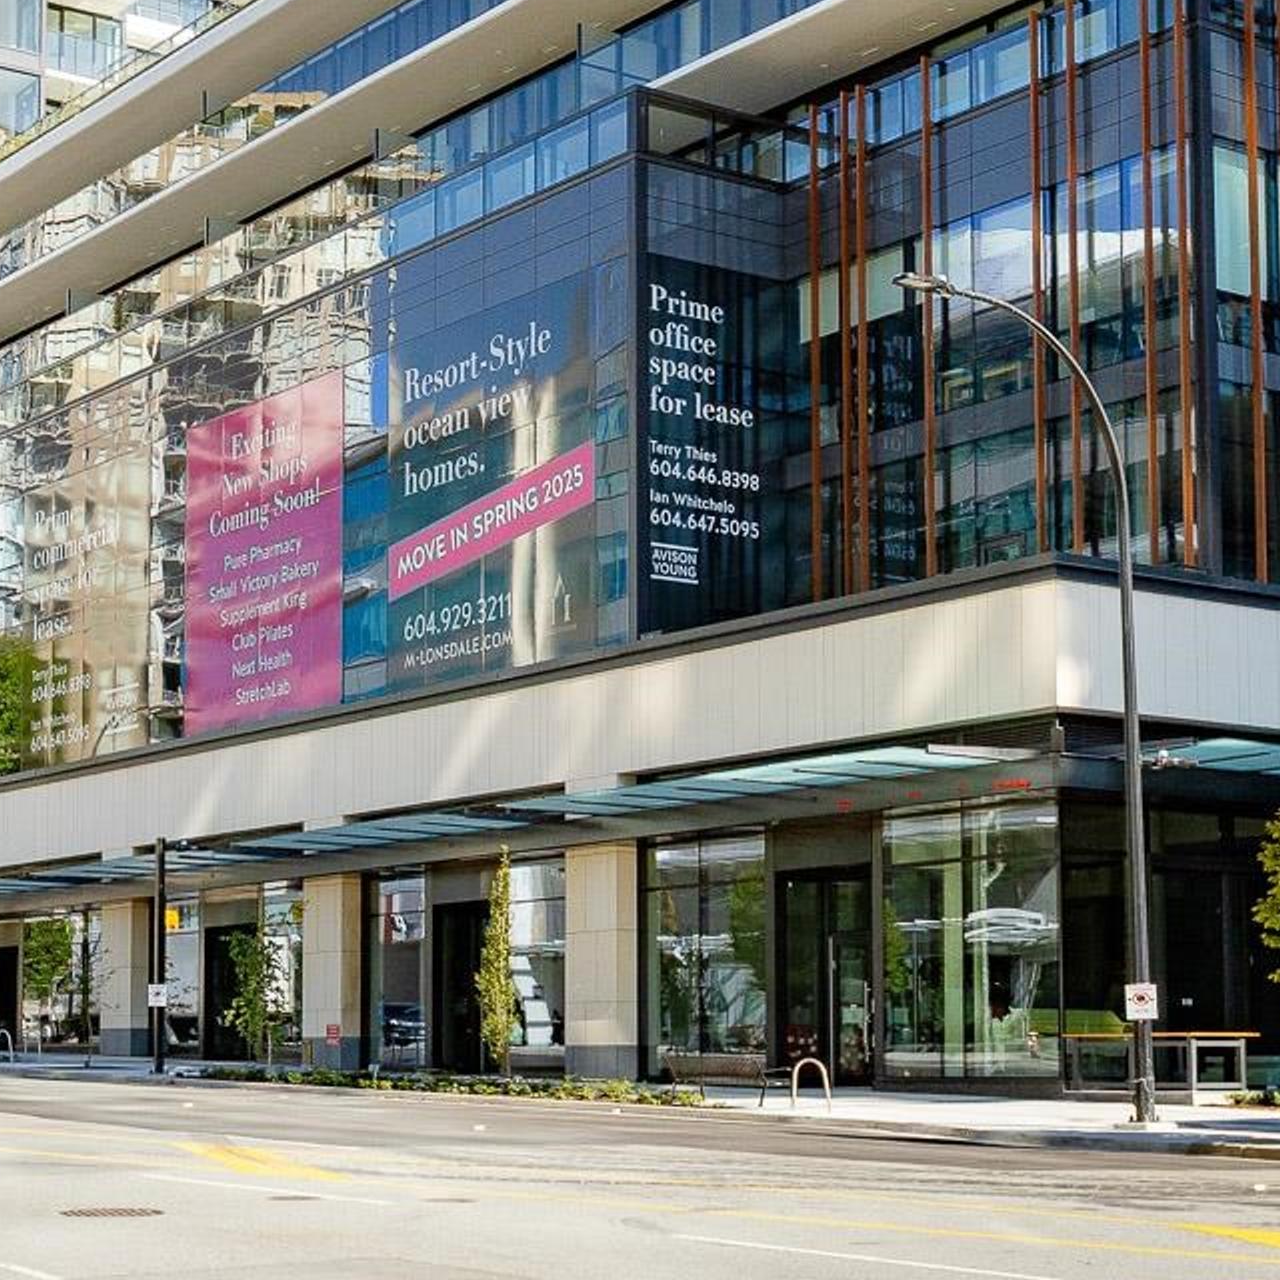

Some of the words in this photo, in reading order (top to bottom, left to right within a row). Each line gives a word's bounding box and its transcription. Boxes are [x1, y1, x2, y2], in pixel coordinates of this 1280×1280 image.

[649, 283, 724, 324] Prime
[649, 322, 717, 356] office
[404, 322, 552, 403] Resort-Style
[649, 356, 716, 385] space
[403, 406, 471, 450] ocean
[478, 382, 532, 434] view
[649, 384, 688, 416] for
[694, 392, 754, 428] lease
[231, 420, 297, 461] Exciting
[649, 439, 682, 460] Terry
[685, 444, 718, 464] Thies
[222, 472, 253, 498] New
[260, 454, 309, 491] Shops
[404, 451, 485, 497] homes.
[649, 459, 760, 492] 604.646.8398
[209, 501, 270, 539] Coming
[272, 476, 321, 518] Soon!
[649, 488, 669, 505] Ian
[397, 534, 448, 579] MOVE
[451, 523, 468, 552] IN
[473, 488, 539, 539] SPRING
[542, 464, 585, 504] 2025
[649, 508, 760, 540] 604.647.5095
[223, 553, 248, 571] Pure
[250, 536, 303, 562] Pharmacy
[652, 549, 697, 566] AVISON
[652, 561, 697, 579] YOUNG
[209, 580, 238, 604] Small
[240, 570, 278, 596] Victory
[282, 559, 320, 584] Bakery
[220, 596, 281, 628] Supplement
[403, 591, 512, 642] 604.929.3211
[232, 632, 257, 652] Club
[259, 622, 294, 643] Pilates
[258, 648, 293, 671] Health
[235, 678, 293, 705] StretchLab
